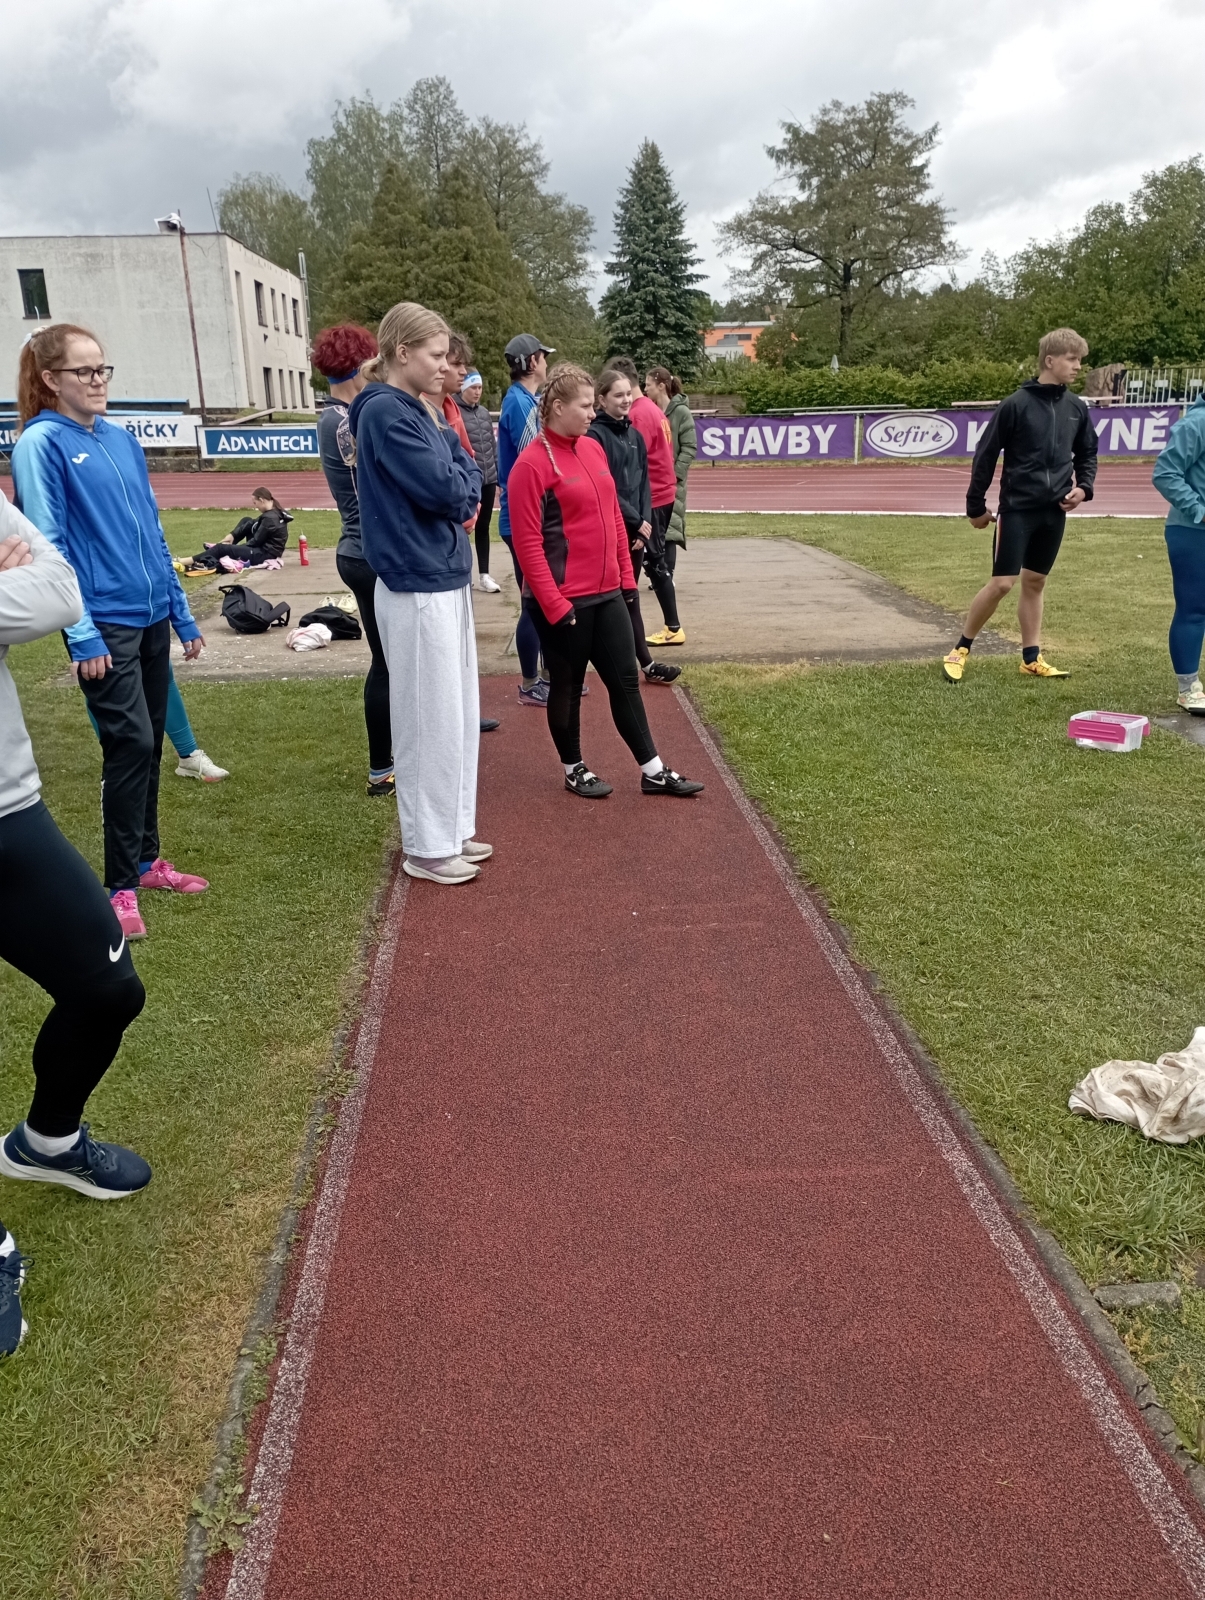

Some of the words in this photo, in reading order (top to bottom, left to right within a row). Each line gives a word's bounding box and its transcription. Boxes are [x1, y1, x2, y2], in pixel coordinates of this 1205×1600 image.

[125, 420, 179, 438] ŘÍČKY
[880, 425, 930, 448] Sefir
[217, 433, 313, 452] ADVANTECH
[701, 424, 837, 457] STAVBY
